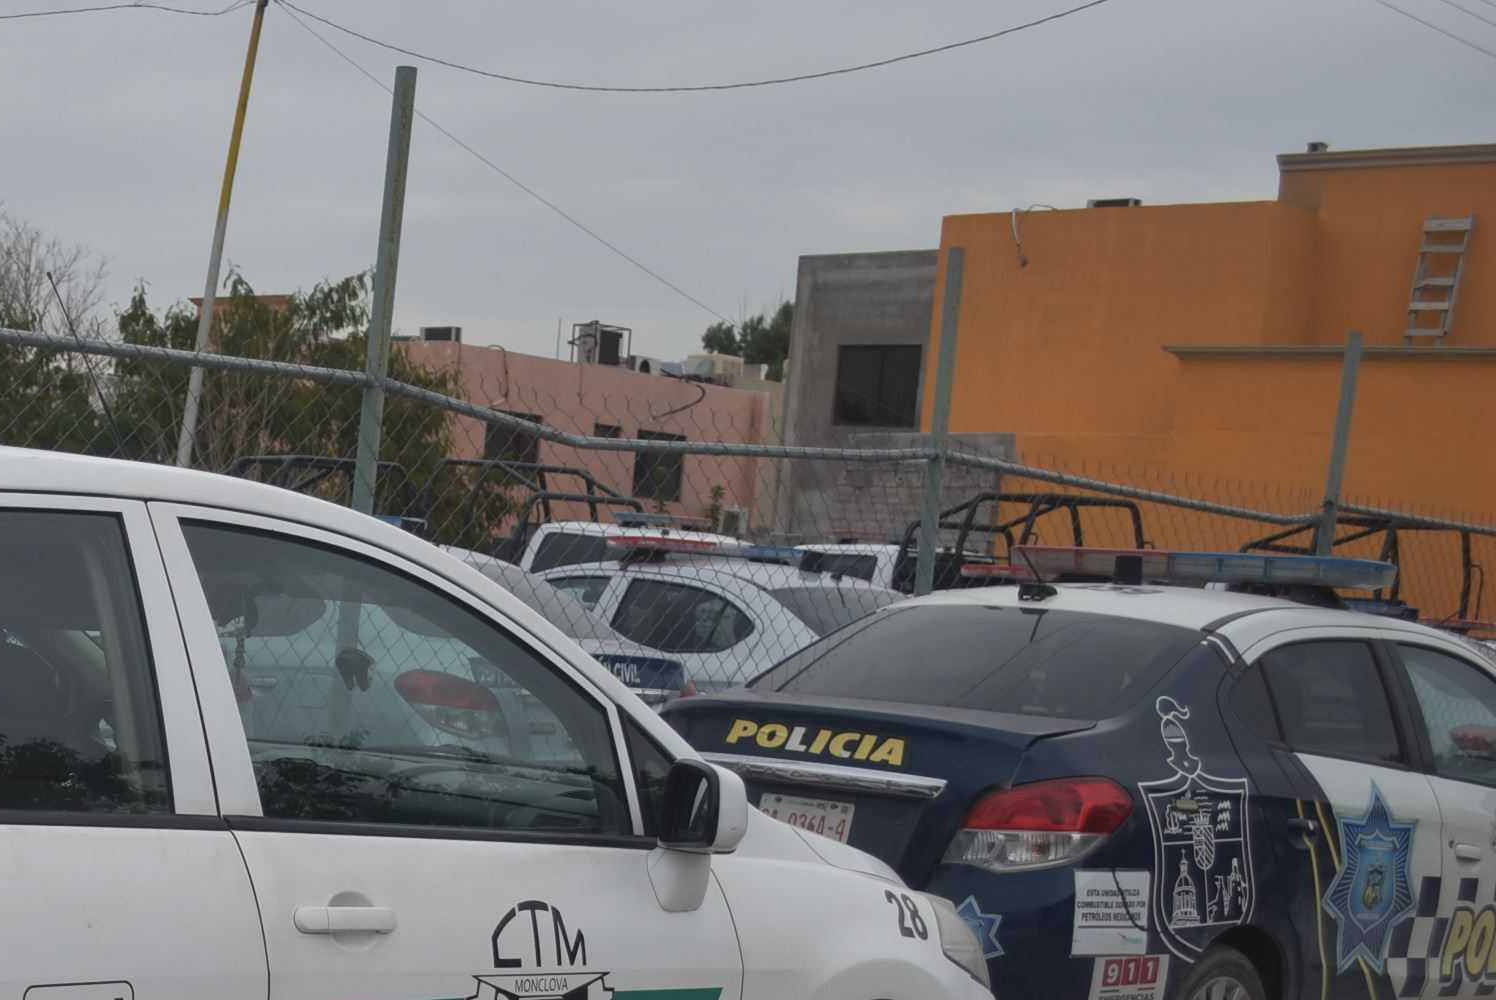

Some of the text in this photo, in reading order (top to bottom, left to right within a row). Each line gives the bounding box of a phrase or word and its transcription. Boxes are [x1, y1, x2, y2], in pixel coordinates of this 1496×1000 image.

[726, 719, 906, 766] POLICIA
[491, 900, 587, 969] CTM
[884, 889, 928, 941] 28
[514, 977, 569, 993] MONCLOVA
[1106, 960, 1155, 984] 911
